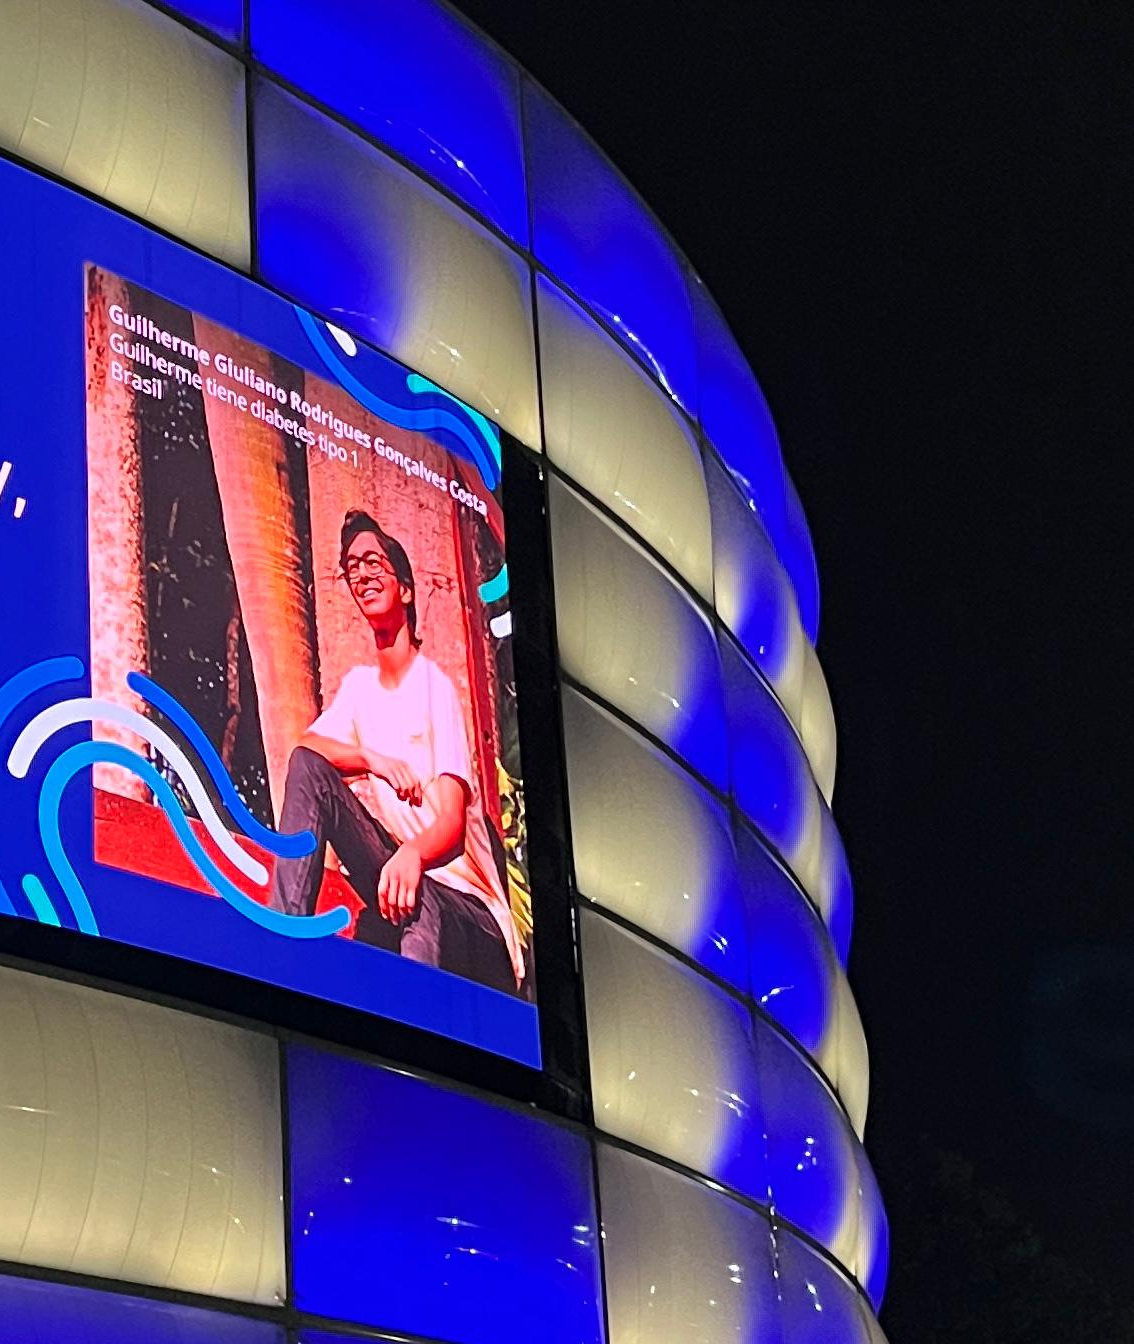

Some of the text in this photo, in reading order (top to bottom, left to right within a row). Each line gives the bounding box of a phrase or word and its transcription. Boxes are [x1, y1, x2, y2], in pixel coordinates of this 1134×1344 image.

[109, 333, 358, 468] Guilherme tiene diabetes tipo 1
[109, 304, 487, 516] Guilherme Giuliano Rodrigues Gonçalves Costa
[111, 361, 163, 400] Brasil
